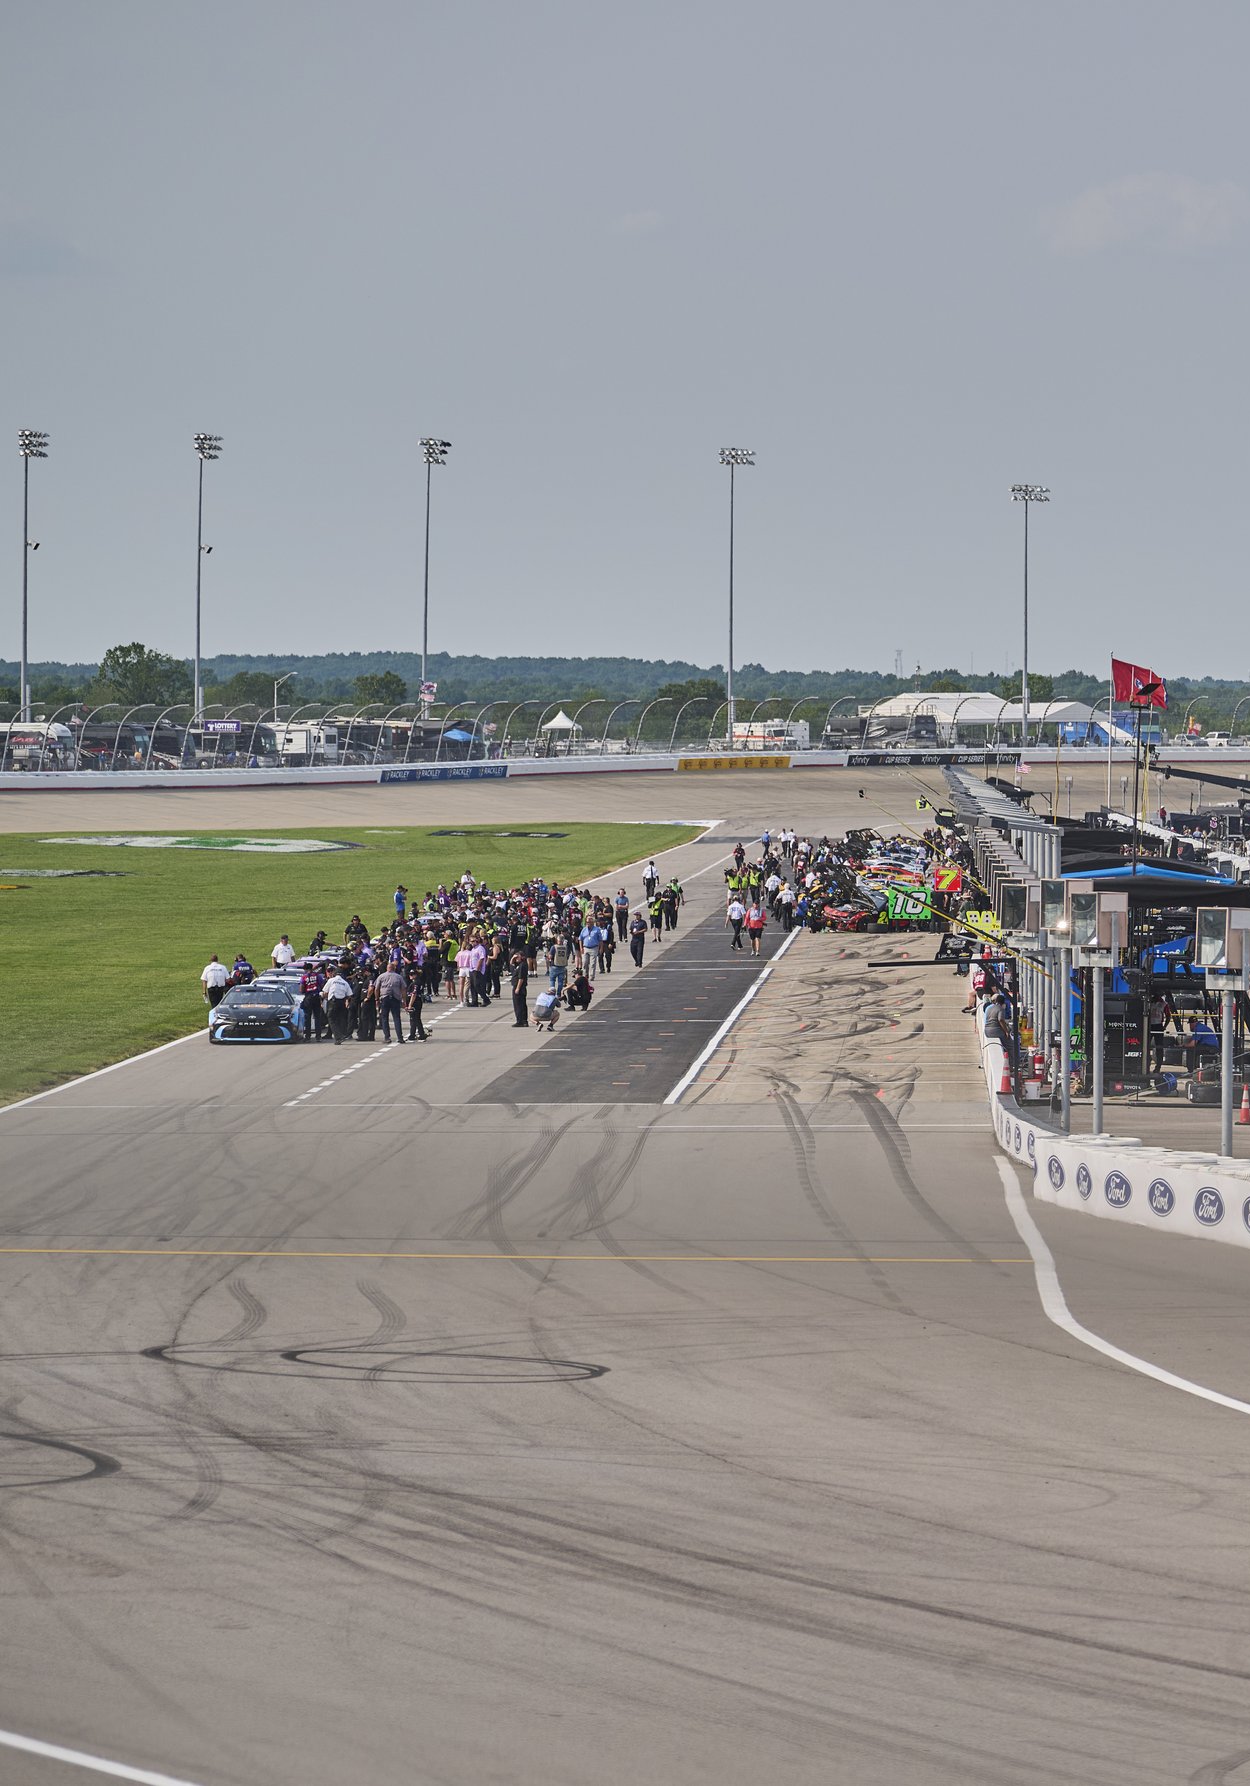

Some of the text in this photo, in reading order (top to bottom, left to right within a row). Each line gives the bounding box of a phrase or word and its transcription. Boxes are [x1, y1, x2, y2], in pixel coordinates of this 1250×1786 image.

[851, 756, 870, 765] xfinity
[921, 755, 941, 764] xfinity
[390, 770, 409, 778] RACKLEY
[421, 769, 441, 777] RACKLEY
[453, 768, 472, 776] RACKLEY
[484, 767, 504, 775] RACKLEY
[937, 869, 958, 889] 7
[1108, 1175, 1126, 1202] Ford
[1152, 1183, 1169, 1210] Ford
[1198, 1192, 1218, 1219] Ford
